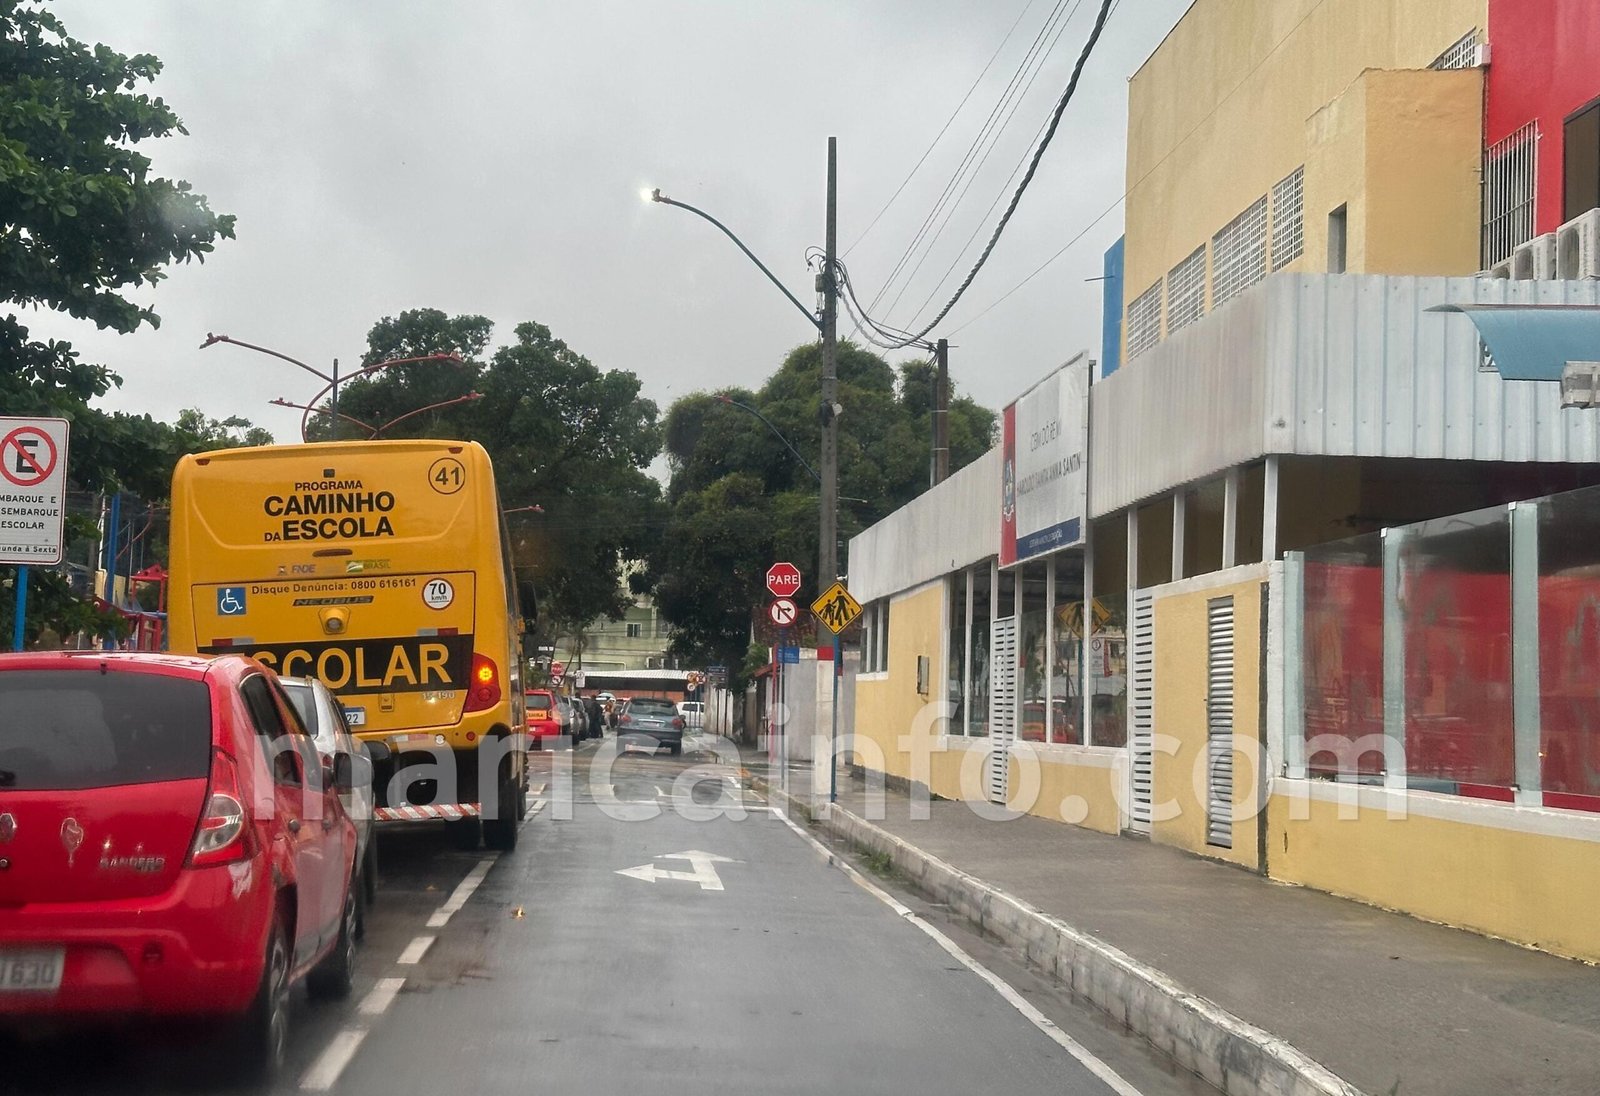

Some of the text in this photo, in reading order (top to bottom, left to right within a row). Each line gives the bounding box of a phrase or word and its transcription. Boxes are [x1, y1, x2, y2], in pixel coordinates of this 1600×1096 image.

[435, 466, 461, 486] 41
[295, 480, 363, 491] PROGRAMA
[264, 491, 395, 517] CAMINHO
[1, 521, 44, 529] ESCOLAR
[264, 516, 395, 542] DA ESCOLA
[363, 561, 391, 570] BRASIL
[768, 575, 799, 585] PARE
[252, 578, 416, 596] Disque Denúncia: 0800 616161
[429, 582, 446, 595] 70
[295, 596, 372, 606] NEOBUS
